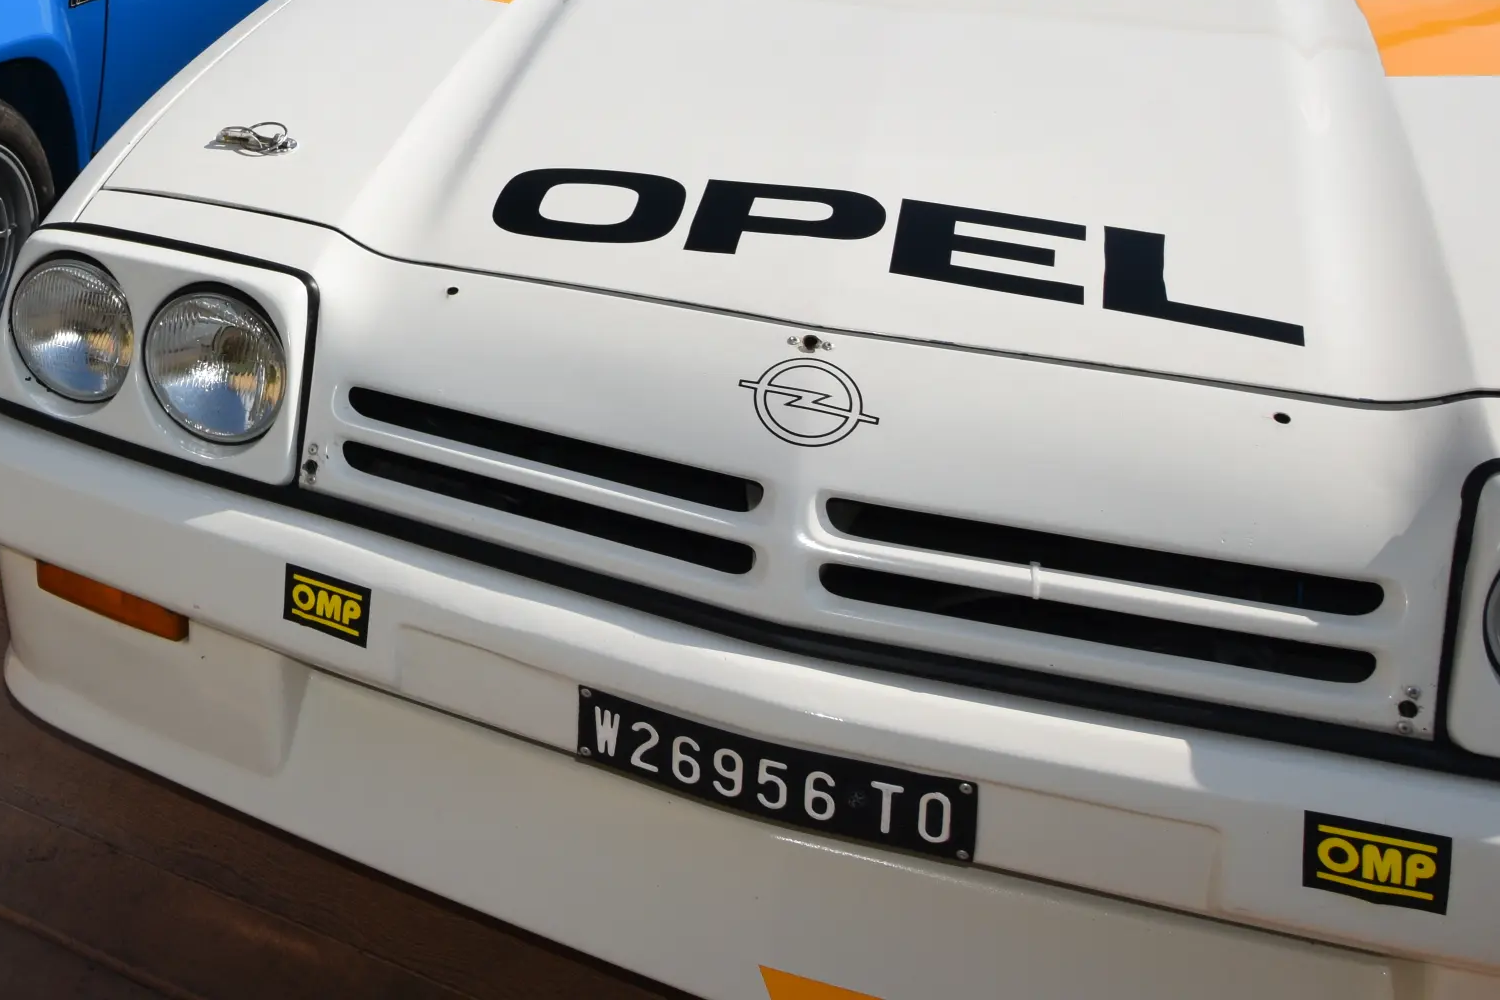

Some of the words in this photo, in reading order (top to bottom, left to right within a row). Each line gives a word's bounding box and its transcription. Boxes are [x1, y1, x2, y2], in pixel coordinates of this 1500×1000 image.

[492, 168, 1305, 347] OPEL
[292, 583, 361, 625] OMP
[594, 705, 836, 822] W26956
[870, 780, 952, 844] TO
[1317, 837, 1437, 888] OMP
